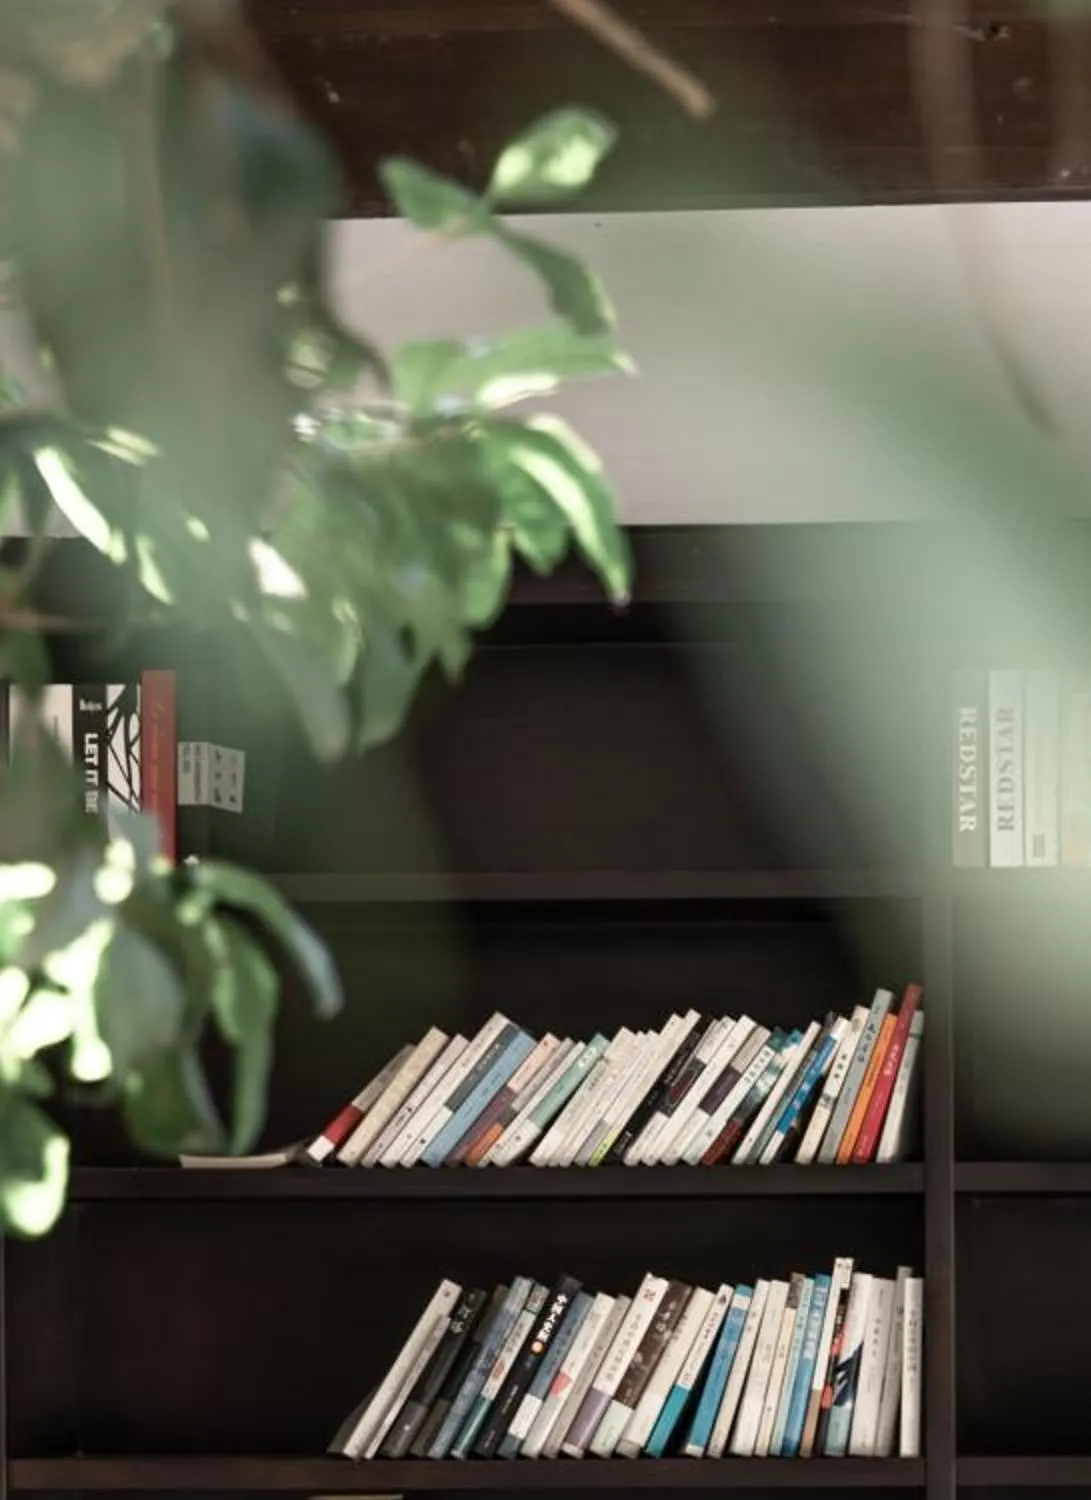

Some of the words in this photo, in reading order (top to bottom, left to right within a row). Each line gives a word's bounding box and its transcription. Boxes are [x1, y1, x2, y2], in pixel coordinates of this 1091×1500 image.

[84, 732, 99, 765] LET
[85, 769, 99, 787] IT
[958, 706, 978, 834] REDSTAR
[995, 706, 1016, 833] REDSTAR
